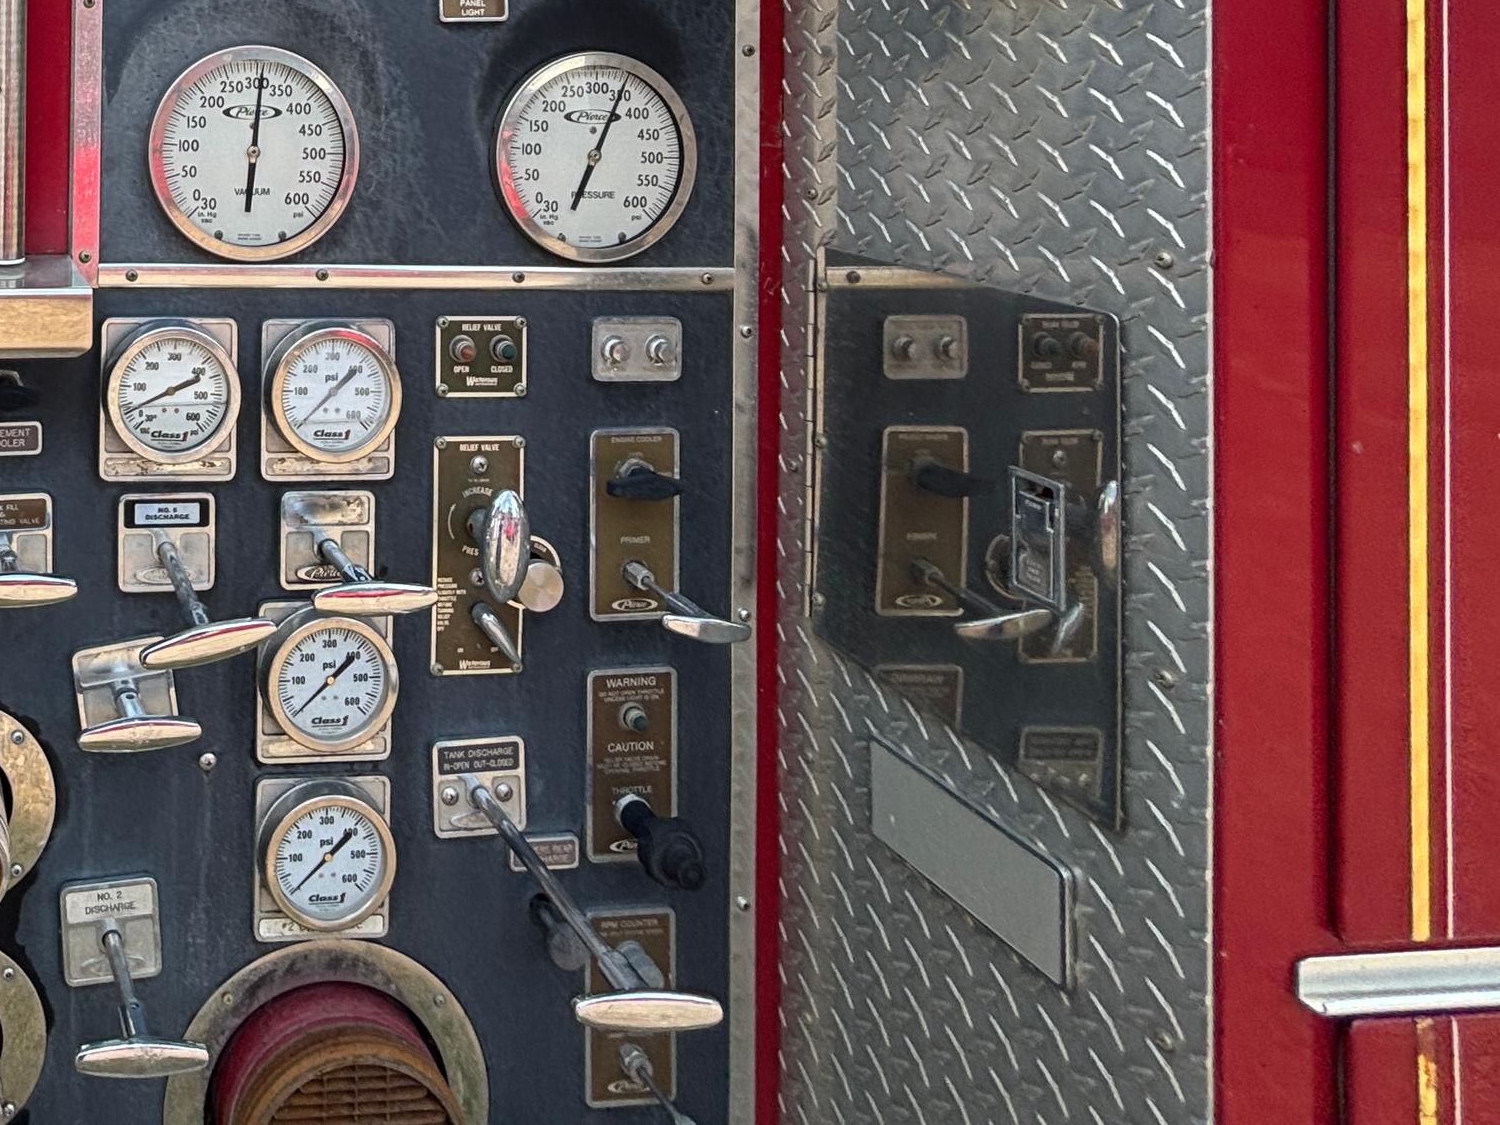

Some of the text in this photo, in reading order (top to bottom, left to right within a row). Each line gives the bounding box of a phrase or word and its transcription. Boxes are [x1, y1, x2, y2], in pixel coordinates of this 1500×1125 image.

[460, 0, 486, 7] PANEL
[461, 8, 485, 16] LIGHT
[220, 81, 243, 93] 250
[269, 85, 292, 97] 350
[561, 86, 585, 98] 250
[585, 82, 609, 94] 300
[200, 96, 225, 108] 200
[542, 100, 566, 113] 200
[286, 103, 311, 115] 400
[625, 107, 649, 119] 400
[186, 116, 206, 128] 150
[529, 120, 549, 133] 150
[298, 124, 322, 136] 450
[637, 129, 660, 141] 450
[178, 139, 199, 152] 100
[521, 143, 542, 156] 100
[302, 147, 326, 160] 500
[640, 151, 664, 164] 500
[181, 165, 197, 178] 50
[298, 170, 321, 183] 550
[524, 168, 539, 181] 50
[636, 175, 659, 187] 550
[201, 197, 217, 210] 30
[284, 193, 310, 205] 600
[623, 196, 647, 209] 600
[543, 200, 558, 213] 30
[453, 365, 470, 373] OPEN
[490, 365, 514, 373] CLOSED
[325, 373, 338, 383] psi
[194, 391, 208, 400] 500
[294, 387, 308, 396] 100
[354, 387, 370, 396] 500
[186, 413, 200, 422] 600
[636, 436, 662, 444] COOLER
[459, 443, 500, 451] RELIEF VALVE
[462, 487, 493, 498] INCREASE
[620, 536, 650, 544] PRIMER
[322, 639, 337, 648] 300
[300, 653, 315, 662] 200
[322, 660, 336, 671] psi
[291, 676, 306, 685] 100
[353, 673, 368, 682] 500
[606, 677, 657, 688] WARNING
[344, 697, 360, 706] 600
[607, 742, 654, 753] CAUTION
[444, 747, 514, 760] TANK DISCHARGE
[444, 758, 514, 771] IN-OPEN OUT-CLOSED
[612, 786, 653, 795] THROTTLE
[319, 816, 334, 825] 300
[297, 830, 312, 840] 200
[319, 837, 334, 848] psi
[289, 853, 303, 862] 100
[350, 850, 366, 859] 500
[342, 874, 357, 883] 600
[97, 890, 123, 902] NO. 2
[85, 901, 136, 915] DISCHARGE
